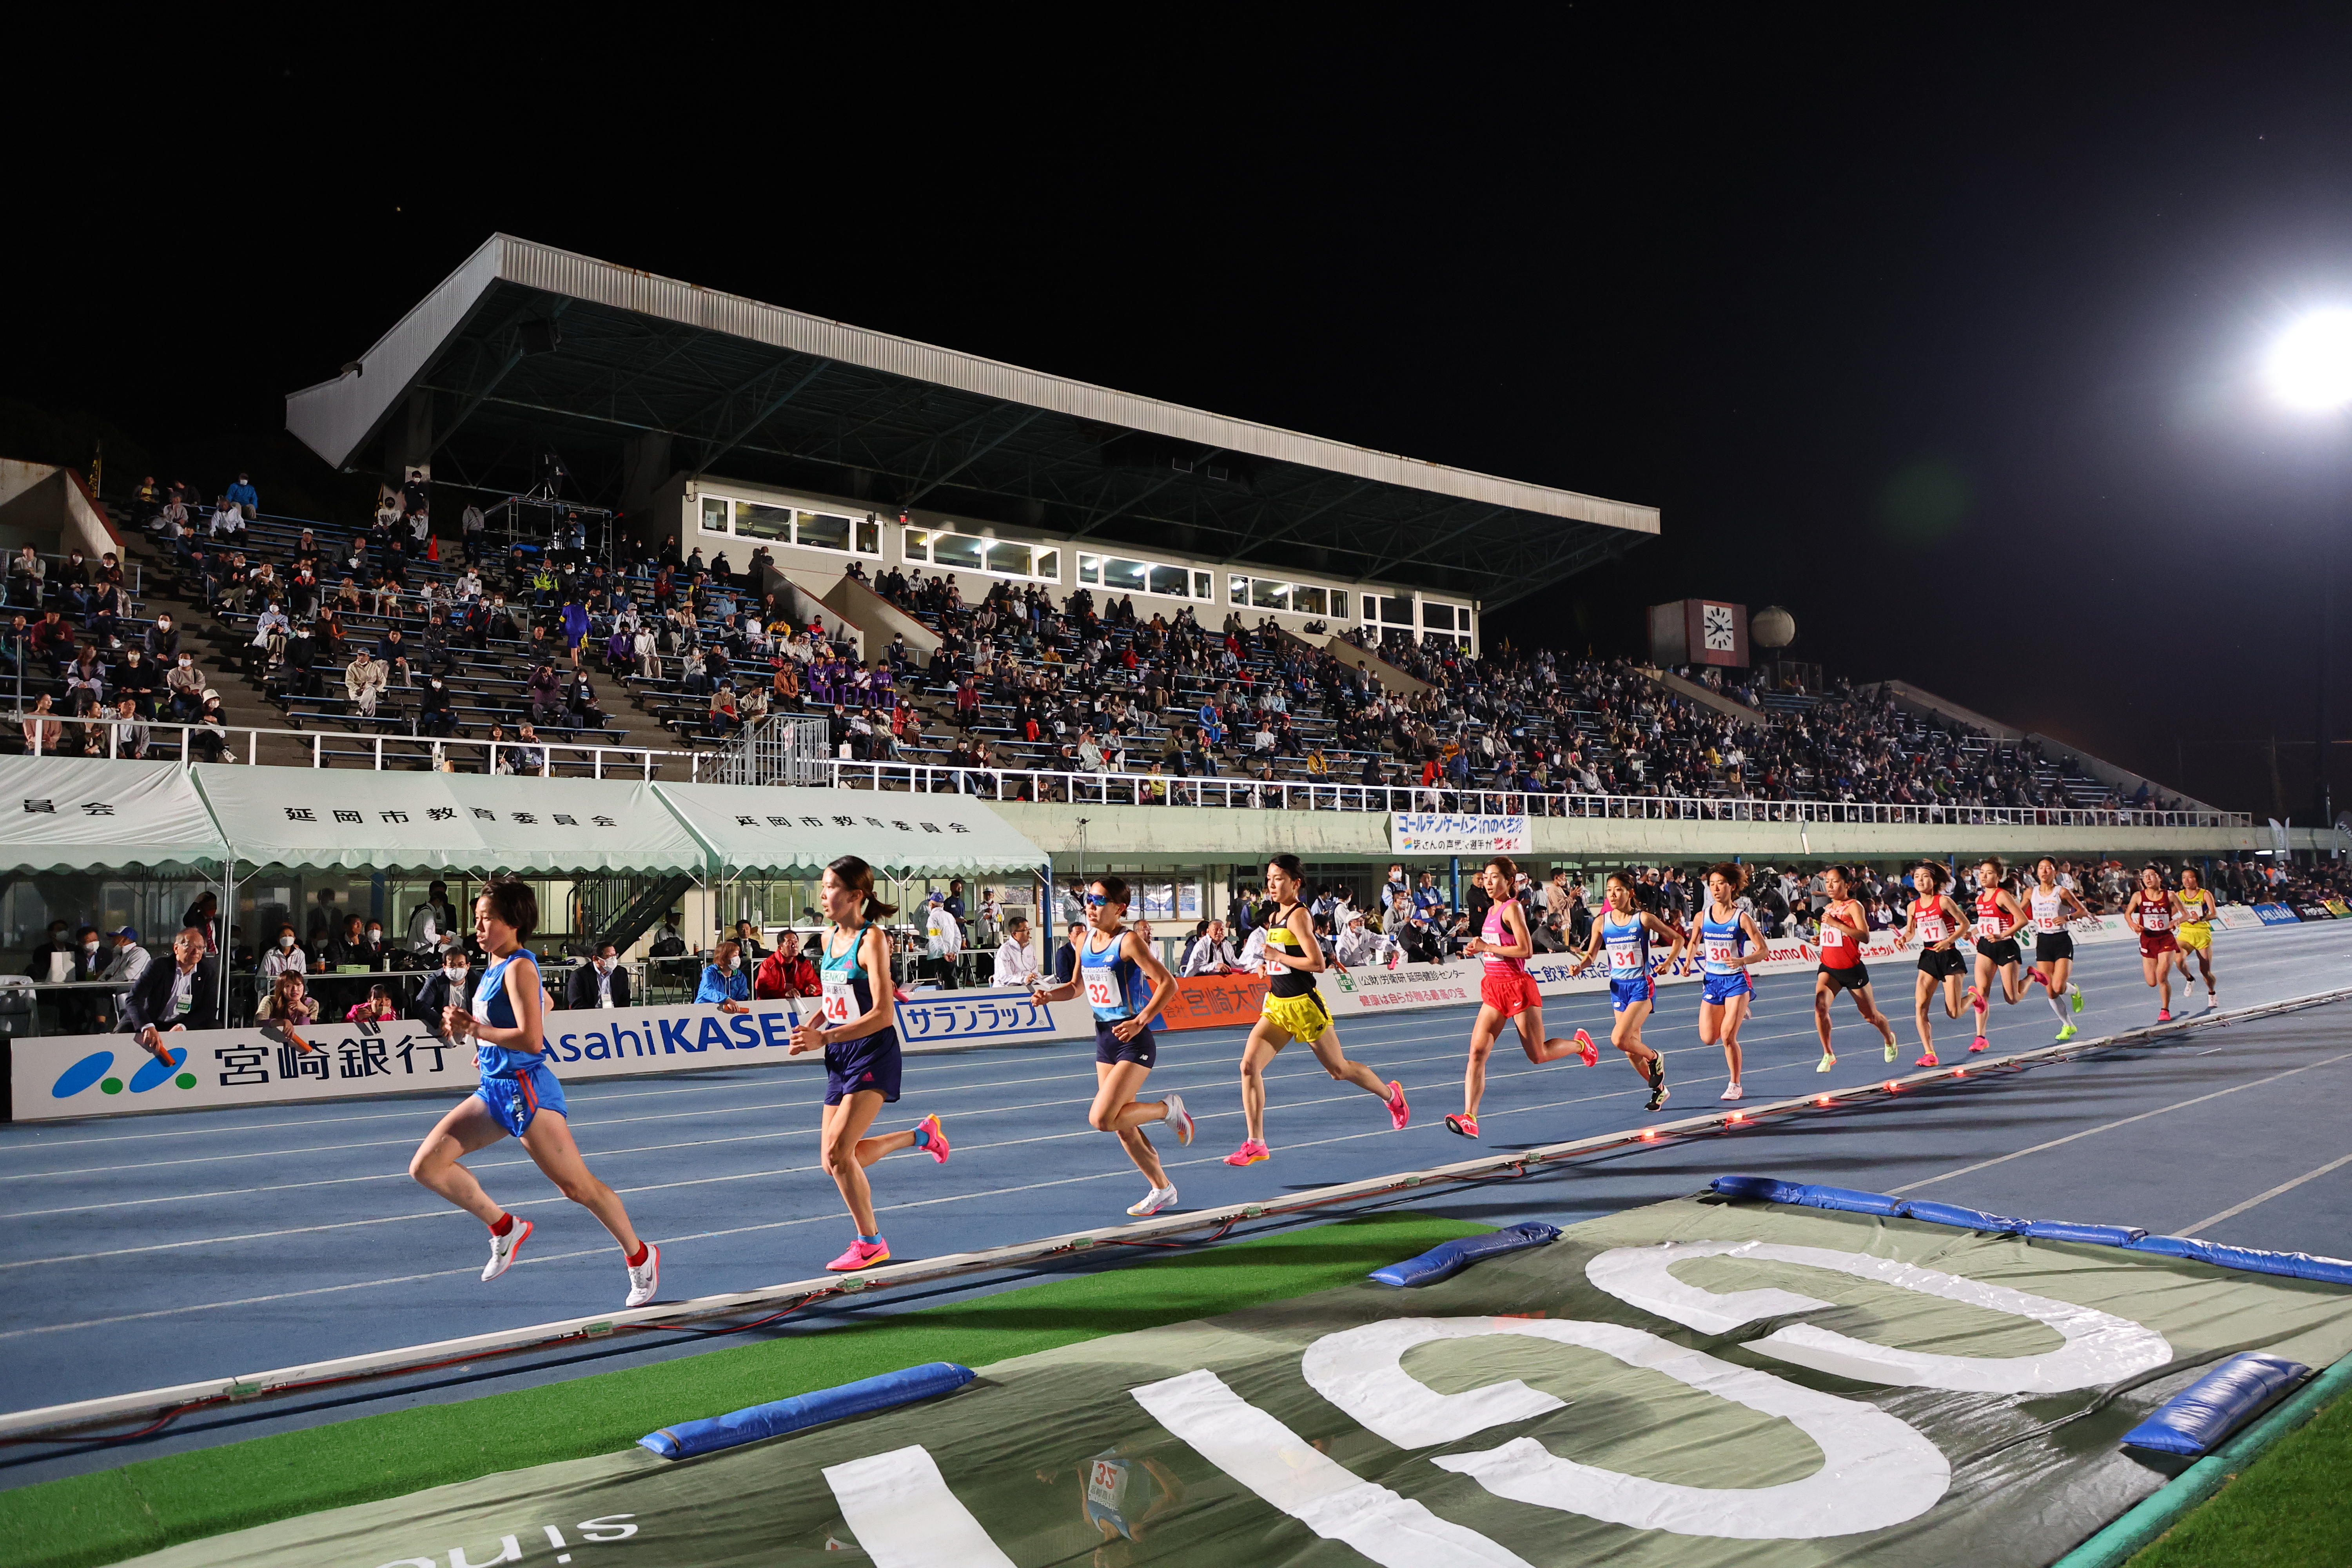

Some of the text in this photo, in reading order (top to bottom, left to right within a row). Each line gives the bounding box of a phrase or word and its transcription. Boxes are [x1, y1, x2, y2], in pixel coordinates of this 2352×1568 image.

[284, 806, 617, 828] 延岡市教育委員会
[735, 815, 971, 835] 延岡市教育委員会
[1980, 923, 1994, 934] 16
[2038, 918, 2053, 928] 15
[2150, 919, 2164, 929] 36
[1606, 934, 1637, 943] Panasonic
[1822, 931, 1834, 944] 10
[1924, 927, 1939, 939] 17
[1615, 951, 1635, 966] 31
[1710, 948, 1730, 961] 30
[1081, 965, 1111, 973] Panasonic
[821, 971, 846, 982] SENKO
[1089, 984, 1111, 1003] 32
[1359, 987, 1468, 1007] 健康は自らが贈る最高の宝
[825, 997, 848, 1019] 24
[214, 1033, 450, 1086] 宮崎銀行
